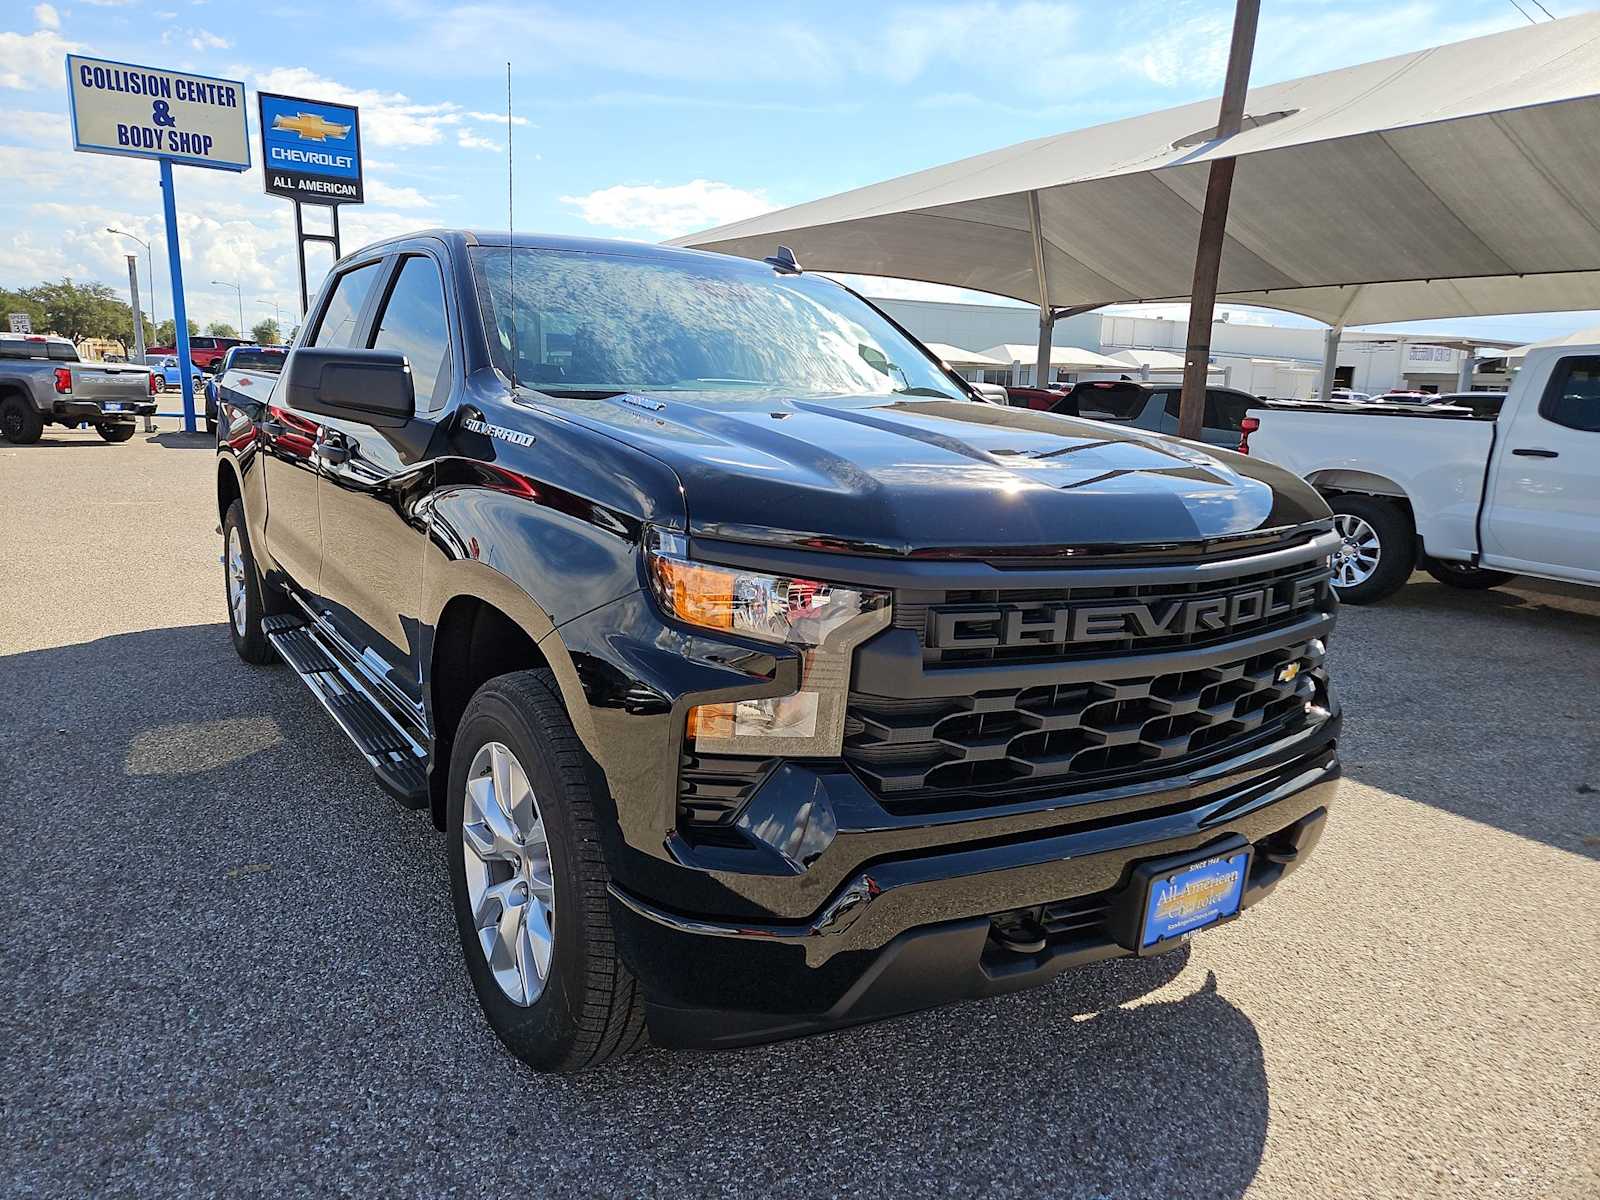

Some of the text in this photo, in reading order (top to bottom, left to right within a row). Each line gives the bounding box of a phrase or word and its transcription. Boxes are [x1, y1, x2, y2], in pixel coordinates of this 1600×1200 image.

[80, 65, 237, 107] COLLISION CENTER
[152, 100, 176, 127] &
[117, 124, 213, 155] BODY SHOP
[271, 147, 353, 168] CHEVROLET
[273, 176, 357, 196] ALL AMERICAN
[464, 418, 535, 447] SILVERADO
[1188, 860, 1207, 872] SINCE
[1157, 870, 1239, 906] All American
